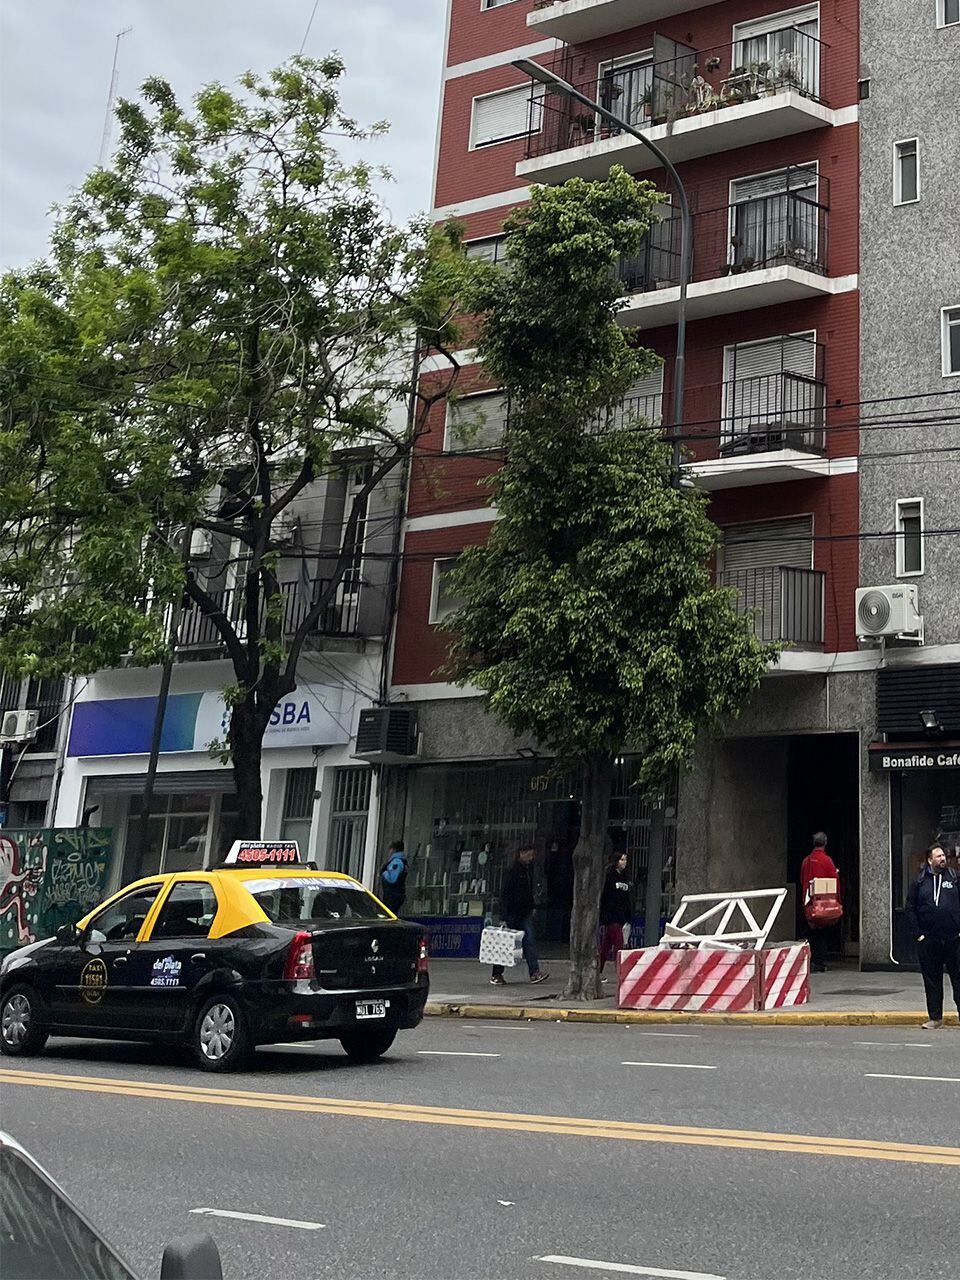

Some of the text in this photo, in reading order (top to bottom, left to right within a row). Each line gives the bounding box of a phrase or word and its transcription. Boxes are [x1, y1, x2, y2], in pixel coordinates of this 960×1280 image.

[269, 701, 311, 725] SBA
[882, 755, 934, 768] Bonafide
[238, 849, 296, 862] 4505-1111
